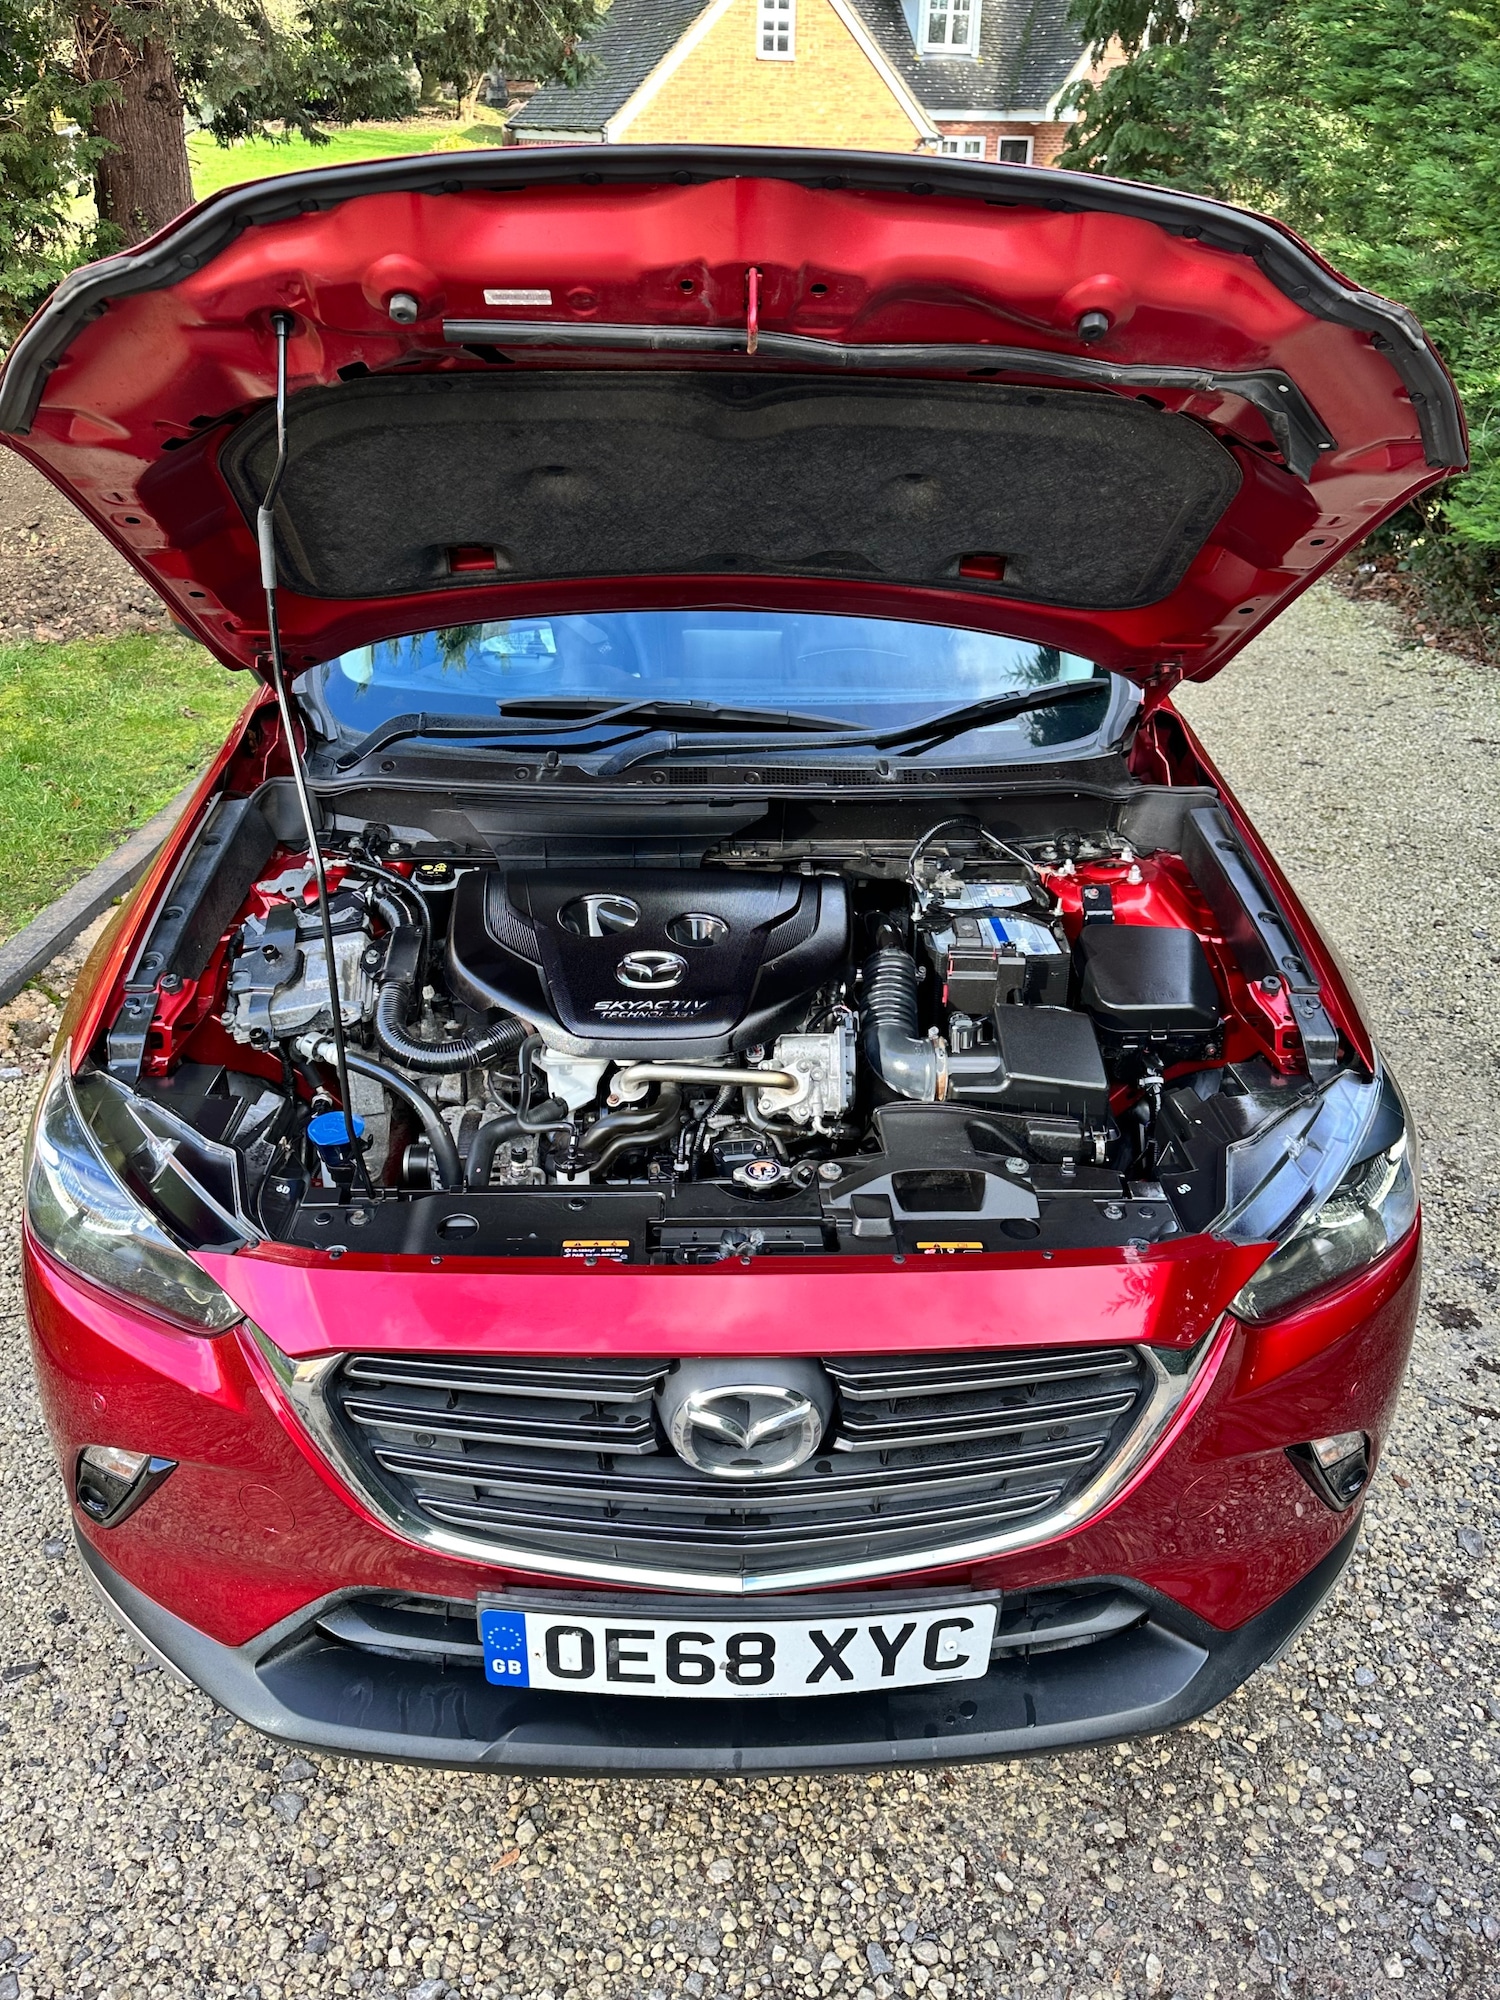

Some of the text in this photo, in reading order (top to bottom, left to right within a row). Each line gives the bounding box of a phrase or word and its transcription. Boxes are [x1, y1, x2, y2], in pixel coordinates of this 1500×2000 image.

[594, 1000, 708, 1011] SKYACTIV
[545, 1617, 974, 1686] OE68 XYC
[492, 1658, 522, 1675] GB
